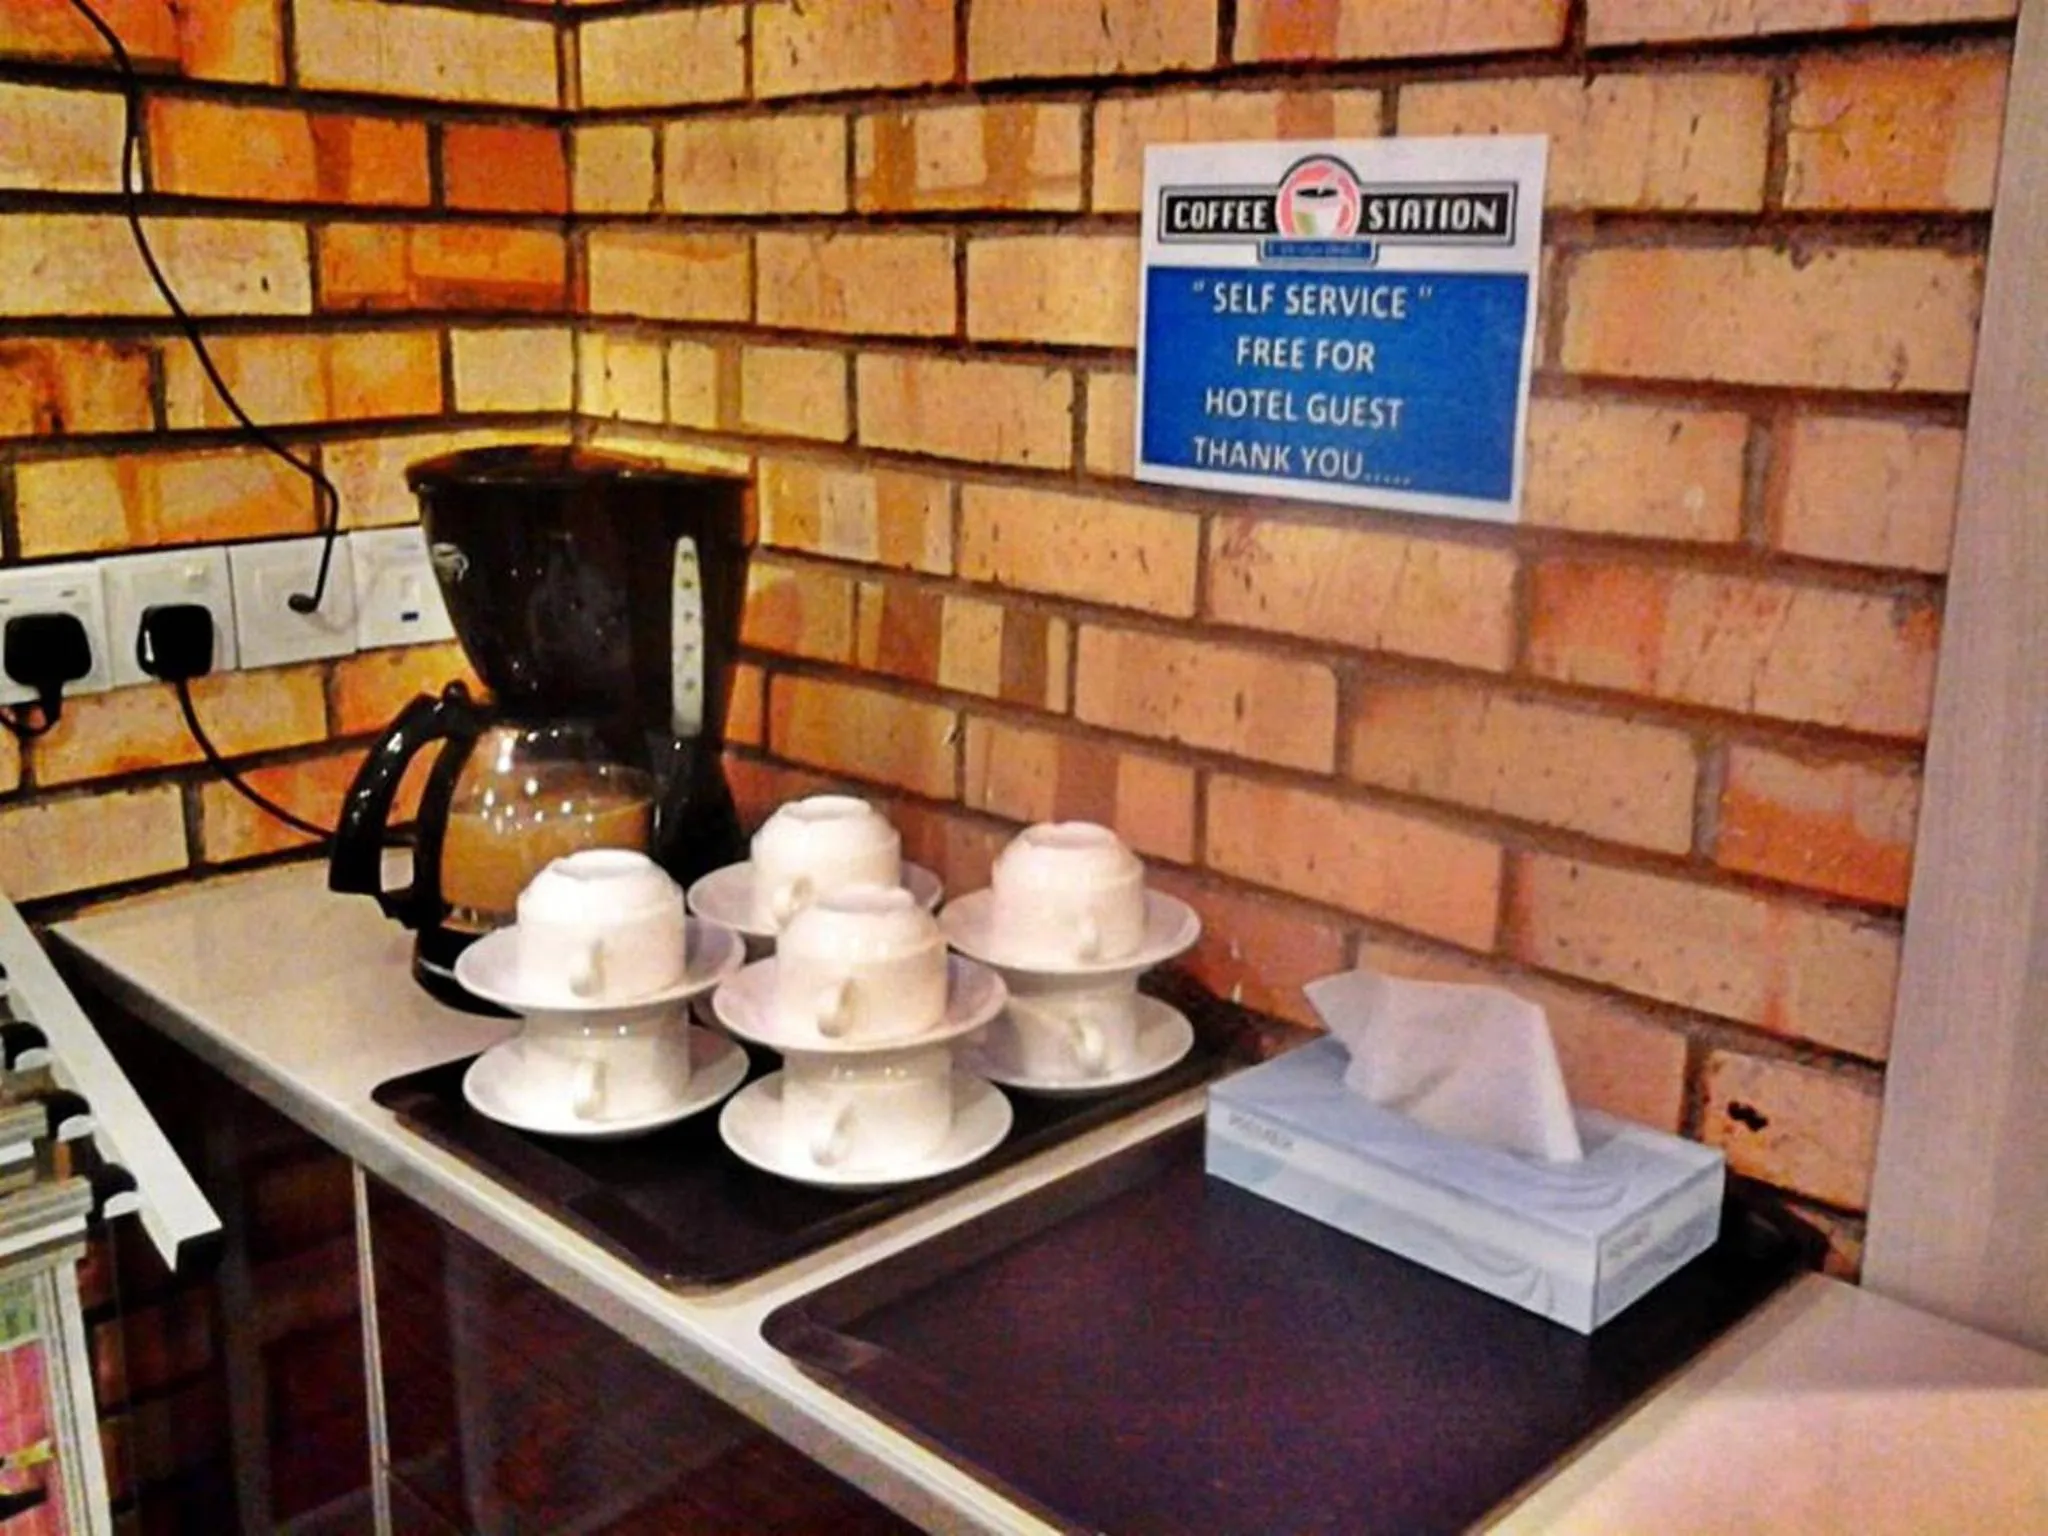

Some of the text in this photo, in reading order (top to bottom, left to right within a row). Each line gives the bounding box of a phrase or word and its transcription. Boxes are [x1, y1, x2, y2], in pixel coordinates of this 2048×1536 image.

[1173, 196, 1498, 233] COFFEE STATION
[1213, 281, 1276, 314] SELF
[1284, 283, 1408, 319] SERVICE
[1236, 335, 1376, 373] FREE FOR
[1205, 387, 1404, 430] HOTEL GUEST
[1193, 435, 1292, 471] THANK
